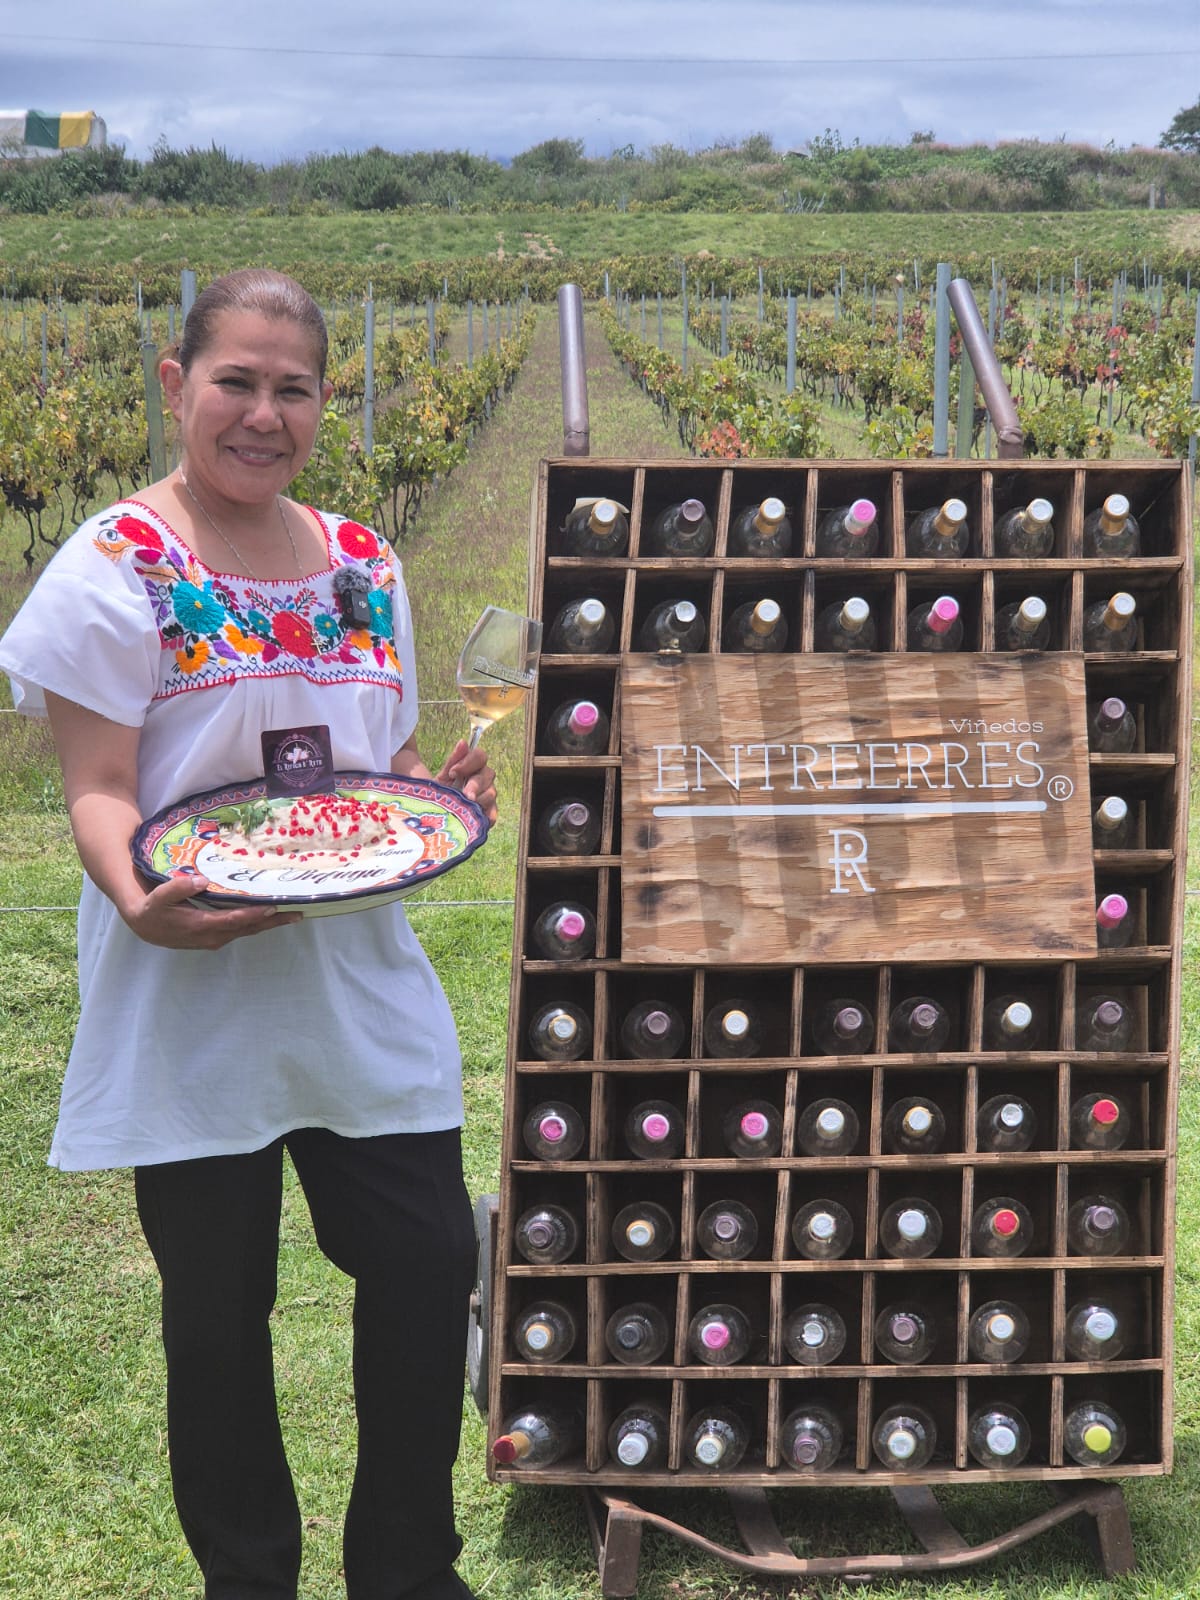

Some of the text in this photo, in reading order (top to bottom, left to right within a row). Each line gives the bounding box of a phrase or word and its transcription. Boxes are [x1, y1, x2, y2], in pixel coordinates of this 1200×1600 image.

[948, 717, 1044, 734] Viñedos
[652, 741, 1045, 793] ENTREERRES
[227, 868, 267, 882] El
